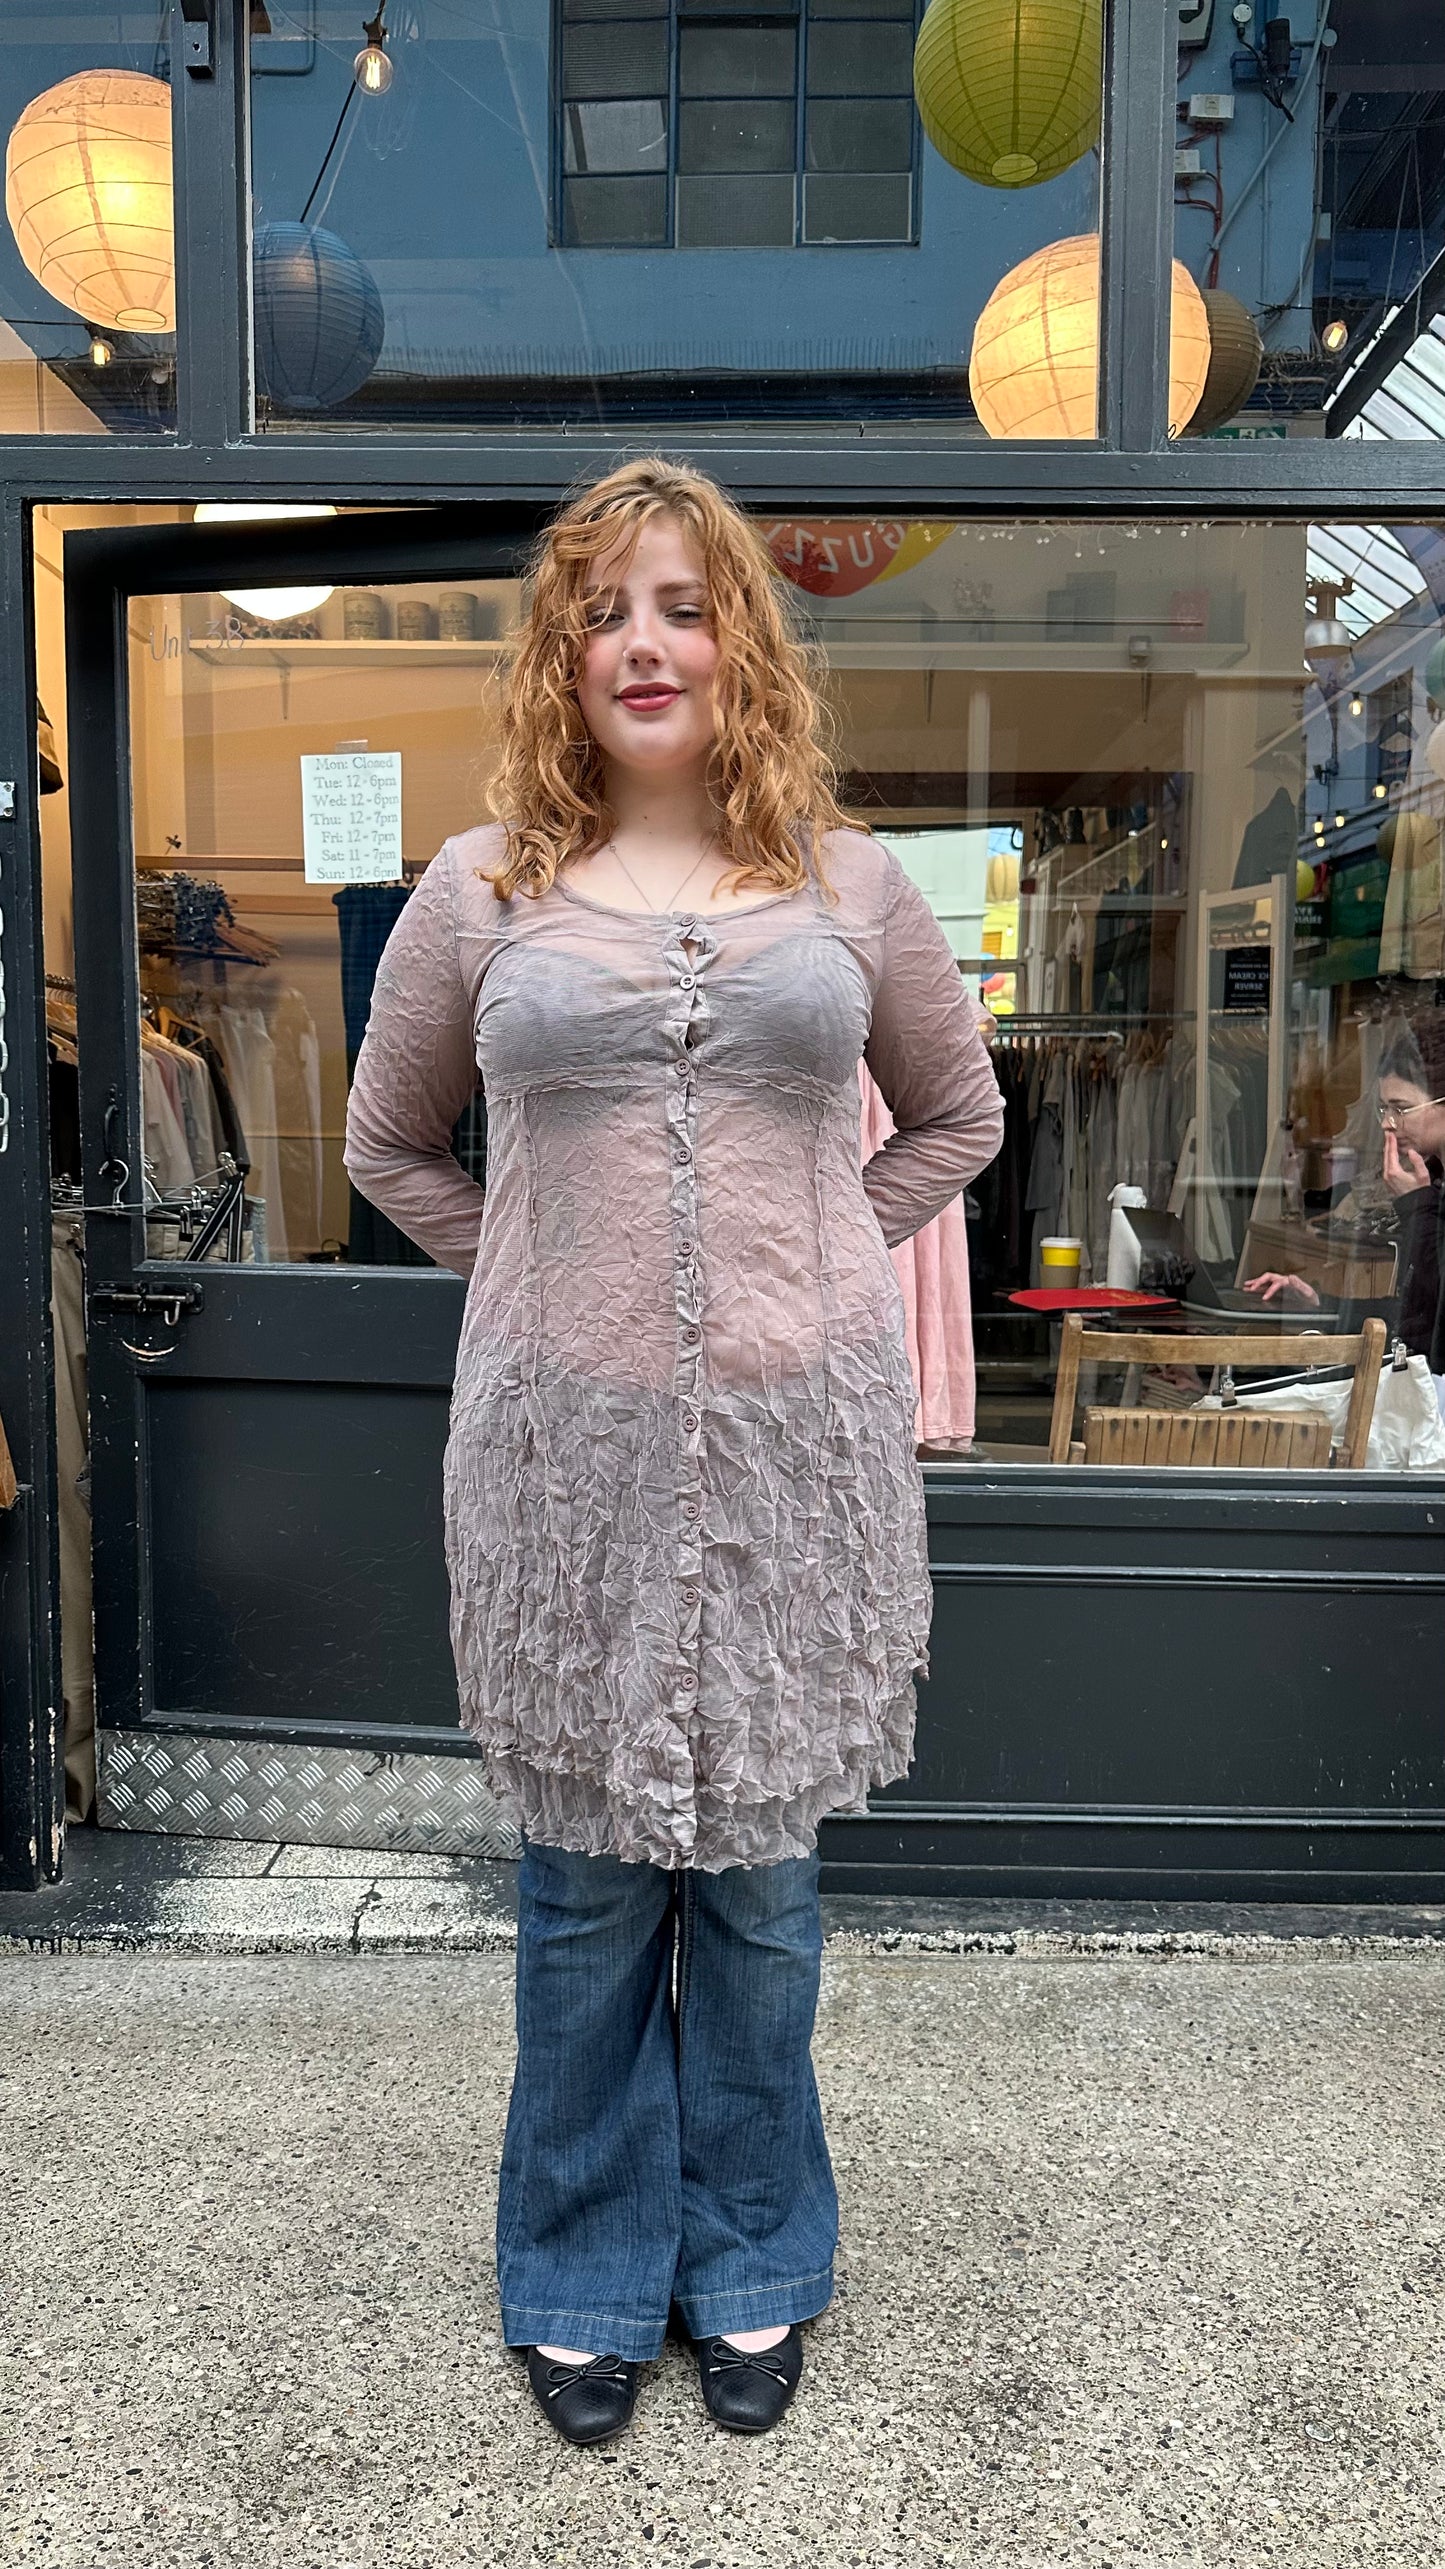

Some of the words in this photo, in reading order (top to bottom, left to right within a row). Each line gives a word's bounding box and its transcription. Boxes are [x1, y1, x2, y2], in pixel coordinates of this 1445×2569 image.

[316, 758, 348, 770] Mon:
[352, 756, 393, 769] Closed
[314, 777, 342, 788] Tue:
[347, 775, 360, 787] 12
[370, 775, 397, 790] 6pm
[312, 795, 347, 807] Wed:
[351, 794, 364, 806] 12
[374, 793, 399, 808] 6pm
[310, 813, 341, 825] Thu:
[350, 811, 364, 824] 12
[374, 811, 398, 826] 7pm
[322, 832, 343, 843] Fri:
[347, 830, 360, 842] 12
[372, 831, 396, 845] 7pm
[322, 850, 345, 861] Sat:
[349, 850, 360, 861] 11
[373, 849, 396, 863] 7pm
[317, 868, 345, 879] Sun:
[350, 867, 363, 879] 12
[374, 868, 398, 881] 6pm
